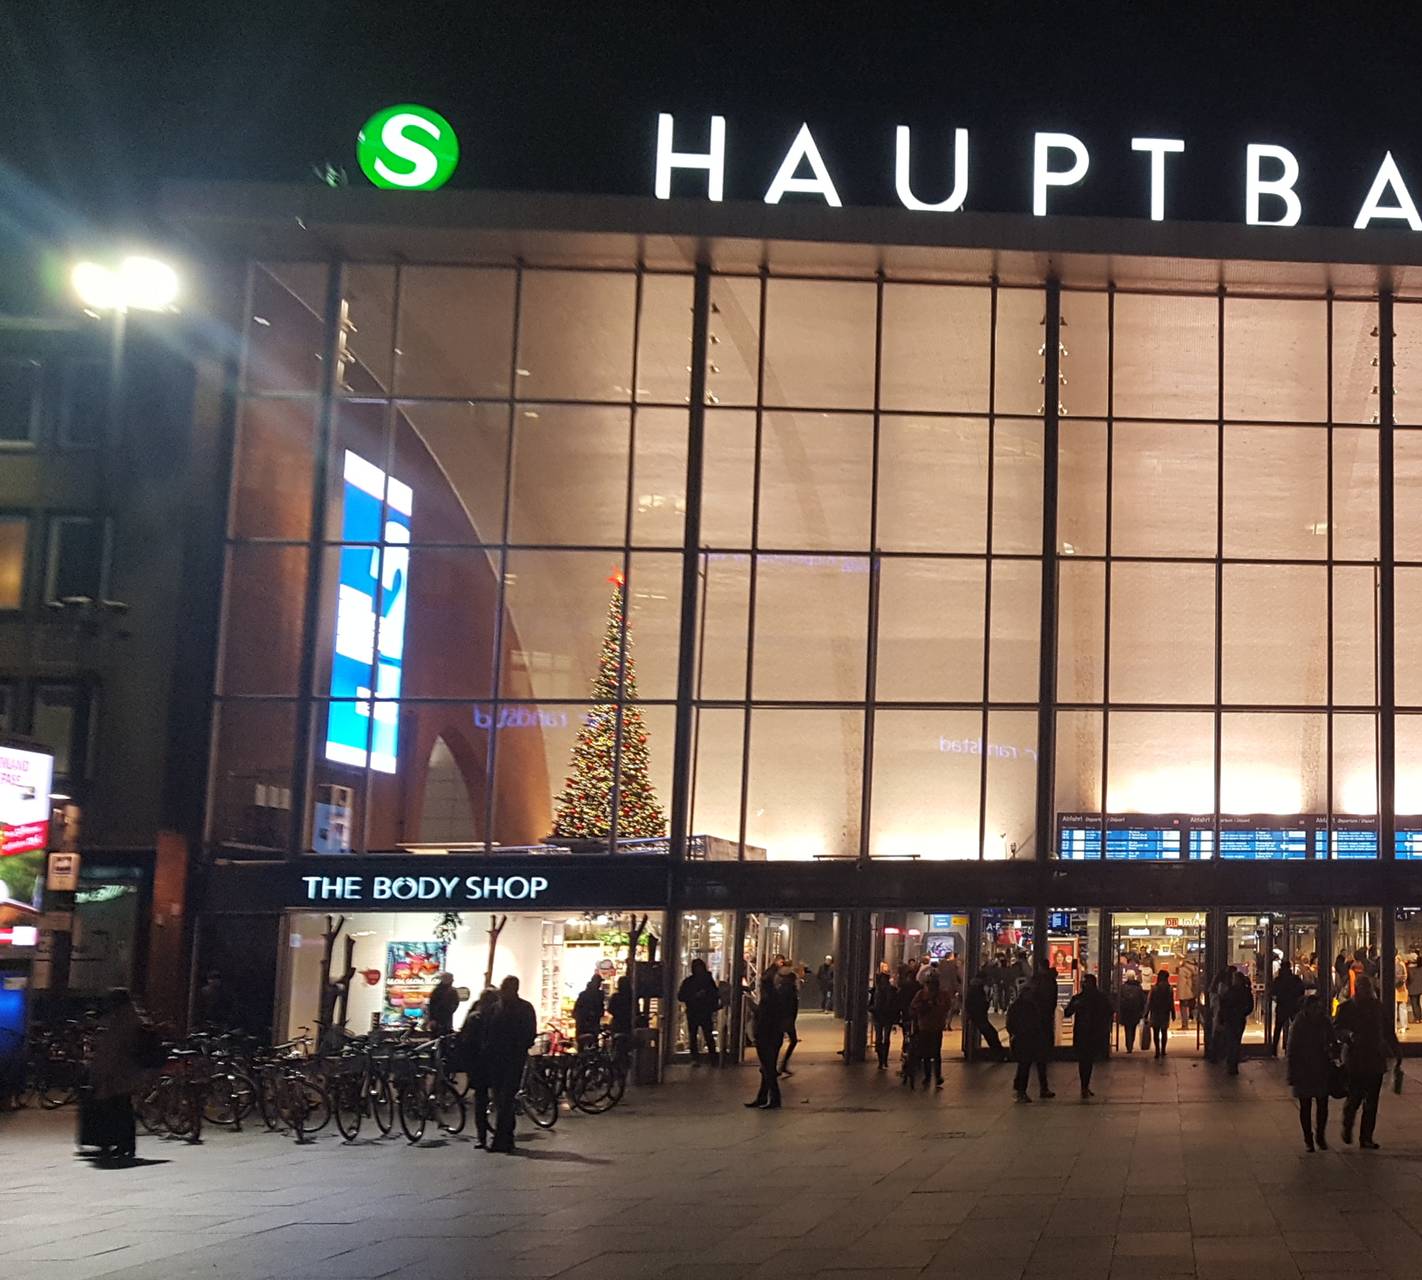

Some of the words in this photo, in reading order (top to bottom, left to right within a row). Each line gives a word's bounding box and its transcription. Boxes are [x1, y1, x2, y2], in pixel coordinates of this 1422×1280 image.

[374, 113, 441, 187] S
[302, 876, 363, 899] THE
[373, 876, 460, 900] BODY
[465, 876, 548, 900] SHOP
